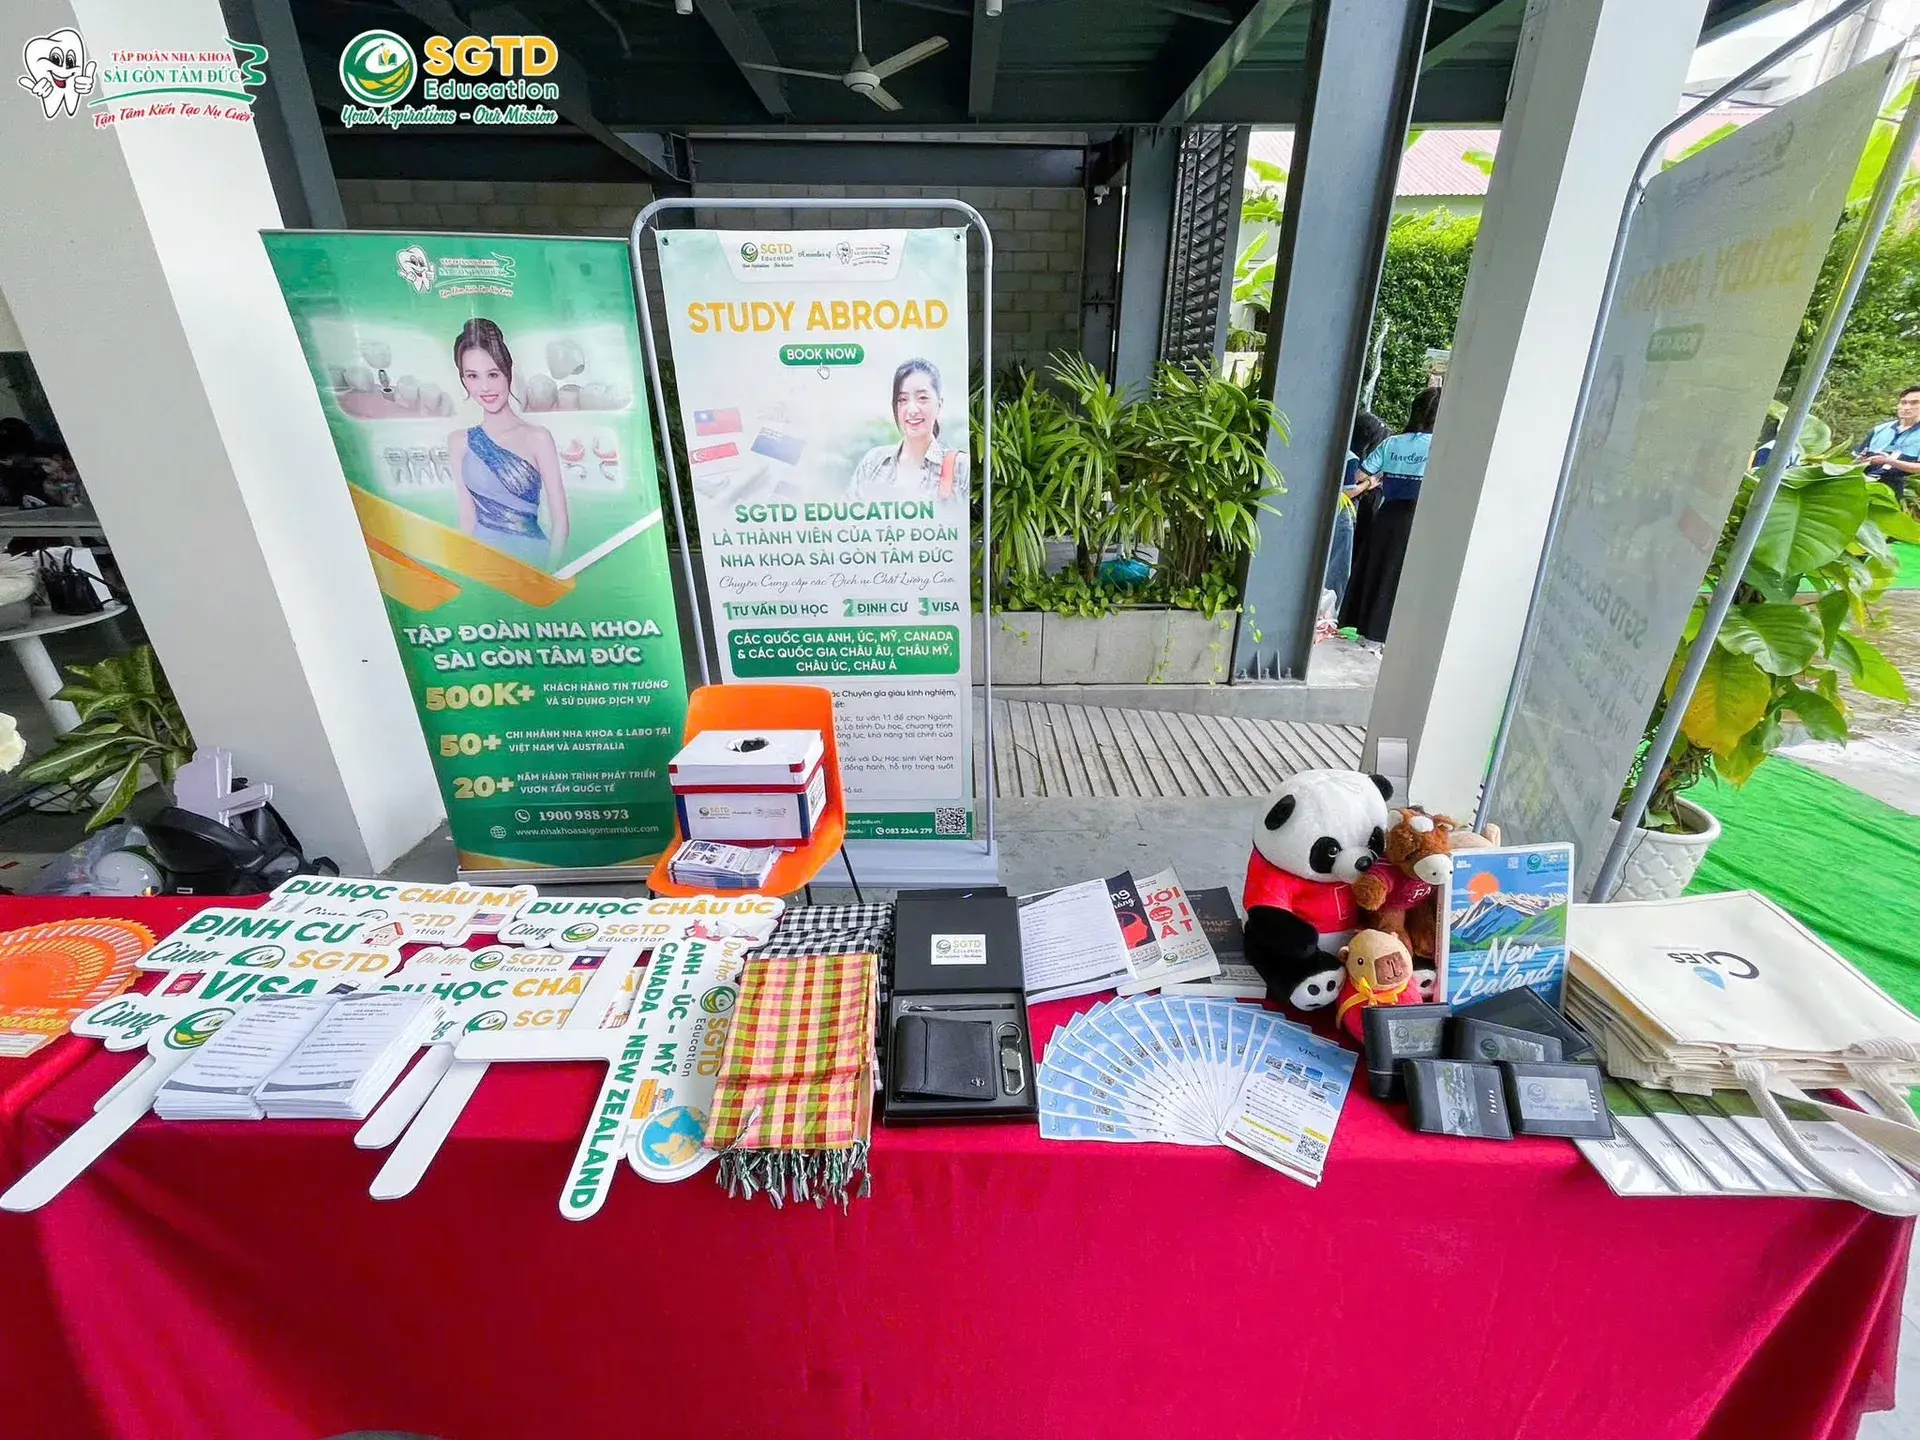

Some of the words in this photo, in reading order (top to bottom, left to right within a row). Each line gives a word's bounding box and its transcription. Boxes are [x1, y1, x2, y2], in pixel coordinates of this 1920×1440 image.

[760, 244, 792, 254] SGTD
[687, 300, 796, 333] STUDY
[806, 299, 950, 331] ABROAD
[787, 349, 823, 360] BOOK
[826, 348, 857, 360] NOW
[735, 503, 797, 523] SGTD
[804, 500, 934, 521] EDUCATION
[712, 530, 733, 546] LÀ
[736, 526, 792, 545] THÀNH
[796, 526, 833, 544] VIÊN
[837, 525, 871, 543] CỦA
[876, 525, 905, 546] TẬP
[910, 525, 958, 542] ĐOÀN
[720, 554, 754, 568] NHA
[759, 552, 805, 567] KHOA
[809, 549, 834, 566] SÀI
[839, 549, 877, 565] GÒN
[880, 548, 914, 565] TÂM
[919, 546, 954, 564] ĐỨC
[733, 605, 749, 616] TƯ
[752, 603, 776, 615] VẤN
[780, 604, 798, 615] DU
[802, 603, 829, 618] HỌC
[857, 602, 887, 615] ĐỊNH
[890, 601, 908, 613] CƯ
[932, 602, 960, 612] VISA
[403, 624, 452, 649] TẬP
[458, 620, 531, 642] ĐOÀN
[536, 621, 587, 639] NHA
[591, 619, 662, 637] KHOA
[734, 631, 761, 645] CÁC
[763, 630, 800, 645] QUỐC
[802, 633, 824, 643] GIA
[827, 632, 855, 644] ANH,
[857, 630, 878, 643] ÚC,
[880, 628, 901, 643] MỸ,
[904, 631, 954, 641] CANADA
[434, 649, 476, 670] SÀI
[481, 645, 533, 667] GÒN
[537, 645, 586, 666] TÂM
[591, 643, 643, 665] ĐỨC
[748, 646, 775, 659] CÁC
[777, 645, 813, 659] QUỐC
[816, 647, 838, 658] GIA
[840, 644, 873, 657] CHÂU
[875, 643, 894, 657] ÂU,
[896, 643, 929, 656] CHÂU
[932, 642, 953, 656] MỸ,
[796, 659, 828, 672] CHÂU
[831, 658, 851, 672] ÚC,
[854, 657, 886, 670] CHÂU
[889, 659, 897, 670] Á
[426, 681, 536, 711] 500K+
[543, 682, 578, 692] KHÁCH
[580, 682, 610, 691] HÀNG
[612, 682, 629, 691] TIN
[632, 680, 669, 690] TƯỞNG
[842, 690, 872, 698] Chuyên
[874, 690, 886, 698] gia
[888, 690, 906, 698] giàu
[546, 696, 560, 705] VÀ
[562, 695, 576, 705] SỬ
[577, 696, 606, 706] DỤNG
[609, 696, 633, 707] DỊCH
[637, 695, 651, 706] VỤ
[506, 731, 523, 739] CHI
[525, 729, 559, 739] NHÁNH
[563, 730, 583, 738] NHA
[585, 729, 613, 737] KHOA
[626, 728, 652, 736] LABO
[655, 727, 671, 737] TẠI
[440, 733, 502, 757] 50+
[509, 743, 530, 754] VIỆT
[533, 743, 555, 751] NAM
[557, 741, 570, 751] VÀ
[572, 742, 625, 751] AUSTRALIA
[517, 771, 540, 781] NĂM
[542, 771, 568, 780] HÀNH
[571, 770, 599, 780] TRÌNH
[601, 770, 626, 779] PHÁT
[629, 768, 656, 779] TRIỂN
[453, 775, 515, 799] 20+
[520, 785, 548, 794] VƯƠN
[551, 783, 570, 793] TẦM
[573, 783, 601, 794] QUỐC
[605, 783, 615, 792] TẾ
[539, 811, 572, 821] 1900
[576, 810, 600, 820] 988
[602, 809, 629, 820] 973
[516, 825, 659, 837] www.nhakhoasaigontamduc.com
[283, 880, 328, 895] DU
[327, 881, 398, 903] HỌC
[399, 884, 480, 904] CHÂU
[480, 887, 528, 907] MỸ
[527, 902, 577, 914] DU
[576, 902, 640, 919] HỌC
[647, 900, 729, 915] CHÂU
[733, 898, 775, 914] ÚC
[183, 914, 288, 942] ĐỊNH
[294, 921, 365, 944] CƯ
[509, 923, 556, 940] Cùng
[604, 924, 671, 935] SGTD
[723, 941, 742, 960] Du
[953, 940, 981, 948] SGTD
[288, 949, 391, 973] SGTD
[417, 952, 439, 965] Du
[438, 954, 466, 967] Học
[506, 953, 565, 966] SGTD
[682, 942, 706, 976] ANH
[1479, 937, 1541, 976] New
[638, 942, 679, 1015] CANADA
[715, 957, 737, 981] Học
[198, 971, 319, 1003] VISA
[1452, 955, 1558, 1005] Zealand
[668, 992, 696, 1020] ÚC
[88, 1001, 170, 1039] Cùng
[681, 1017, 707, 1077] Education
[697, 1018, 728, 1076] SGTD
[615, 1034, 648, 1082] NEW
[651, 1042, 677, 1075] MỸ
[569, 1088, 630, 1209] ZEALAND
